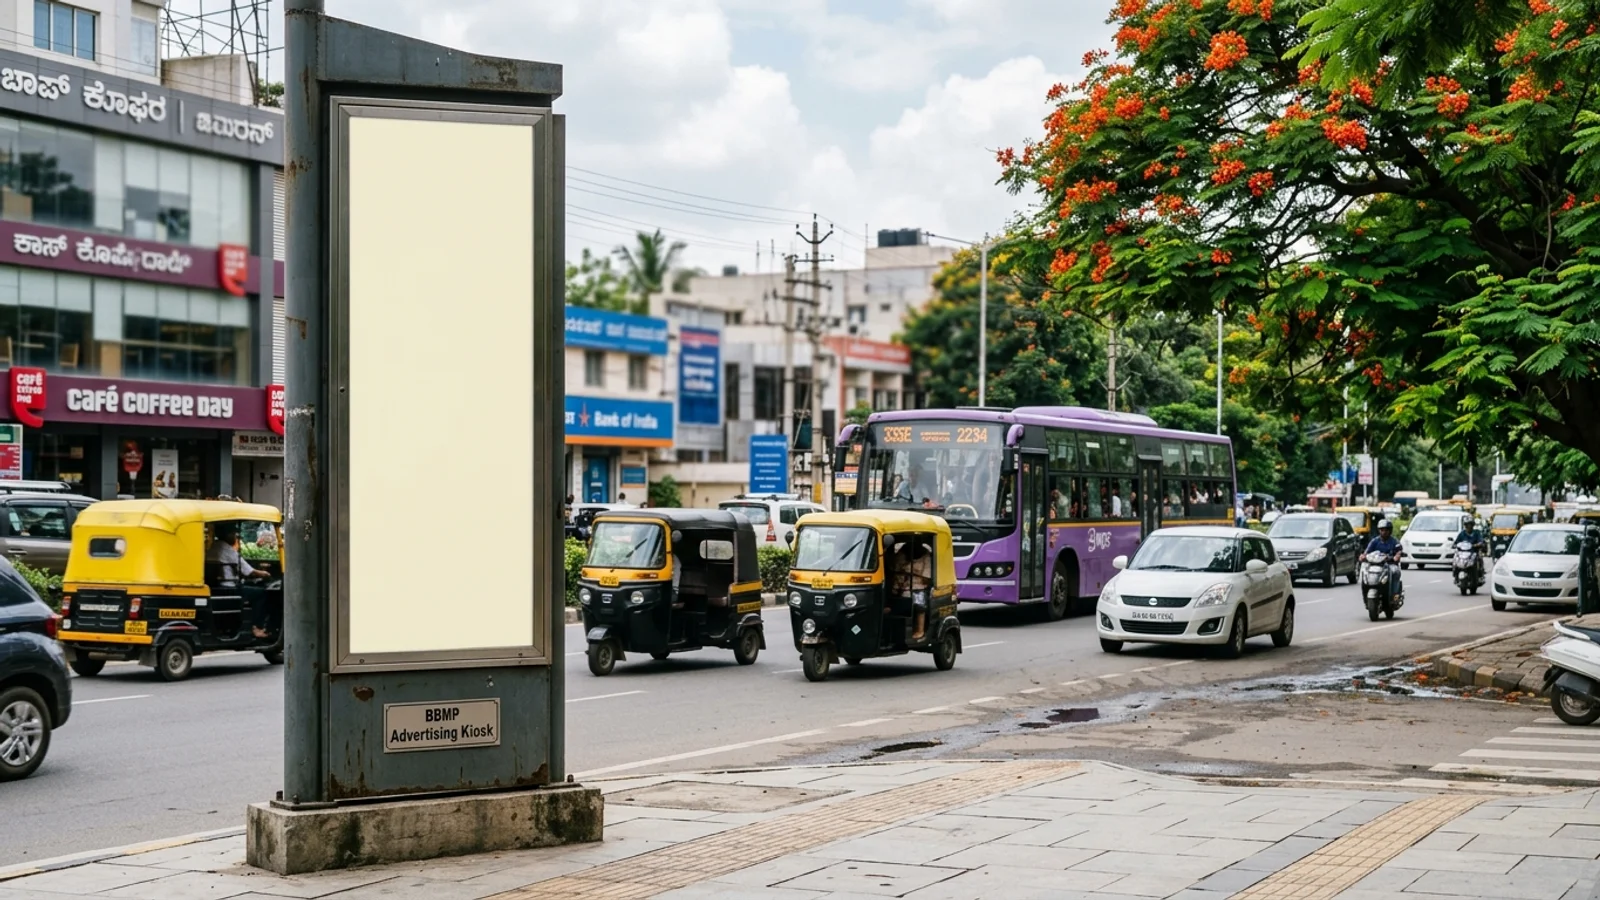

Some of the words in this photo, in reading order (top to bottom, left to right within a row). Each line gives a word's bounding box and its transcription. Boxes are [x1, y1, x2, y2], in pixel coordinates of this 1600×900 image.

[594, 411, 619, 427] Bank
[957, 427, 988, 443] 2234
[425, 707, 460, 722] BBMP
[390, 727, 458, 743] Advertising
[461, 723, 493, 738] Kiosk
